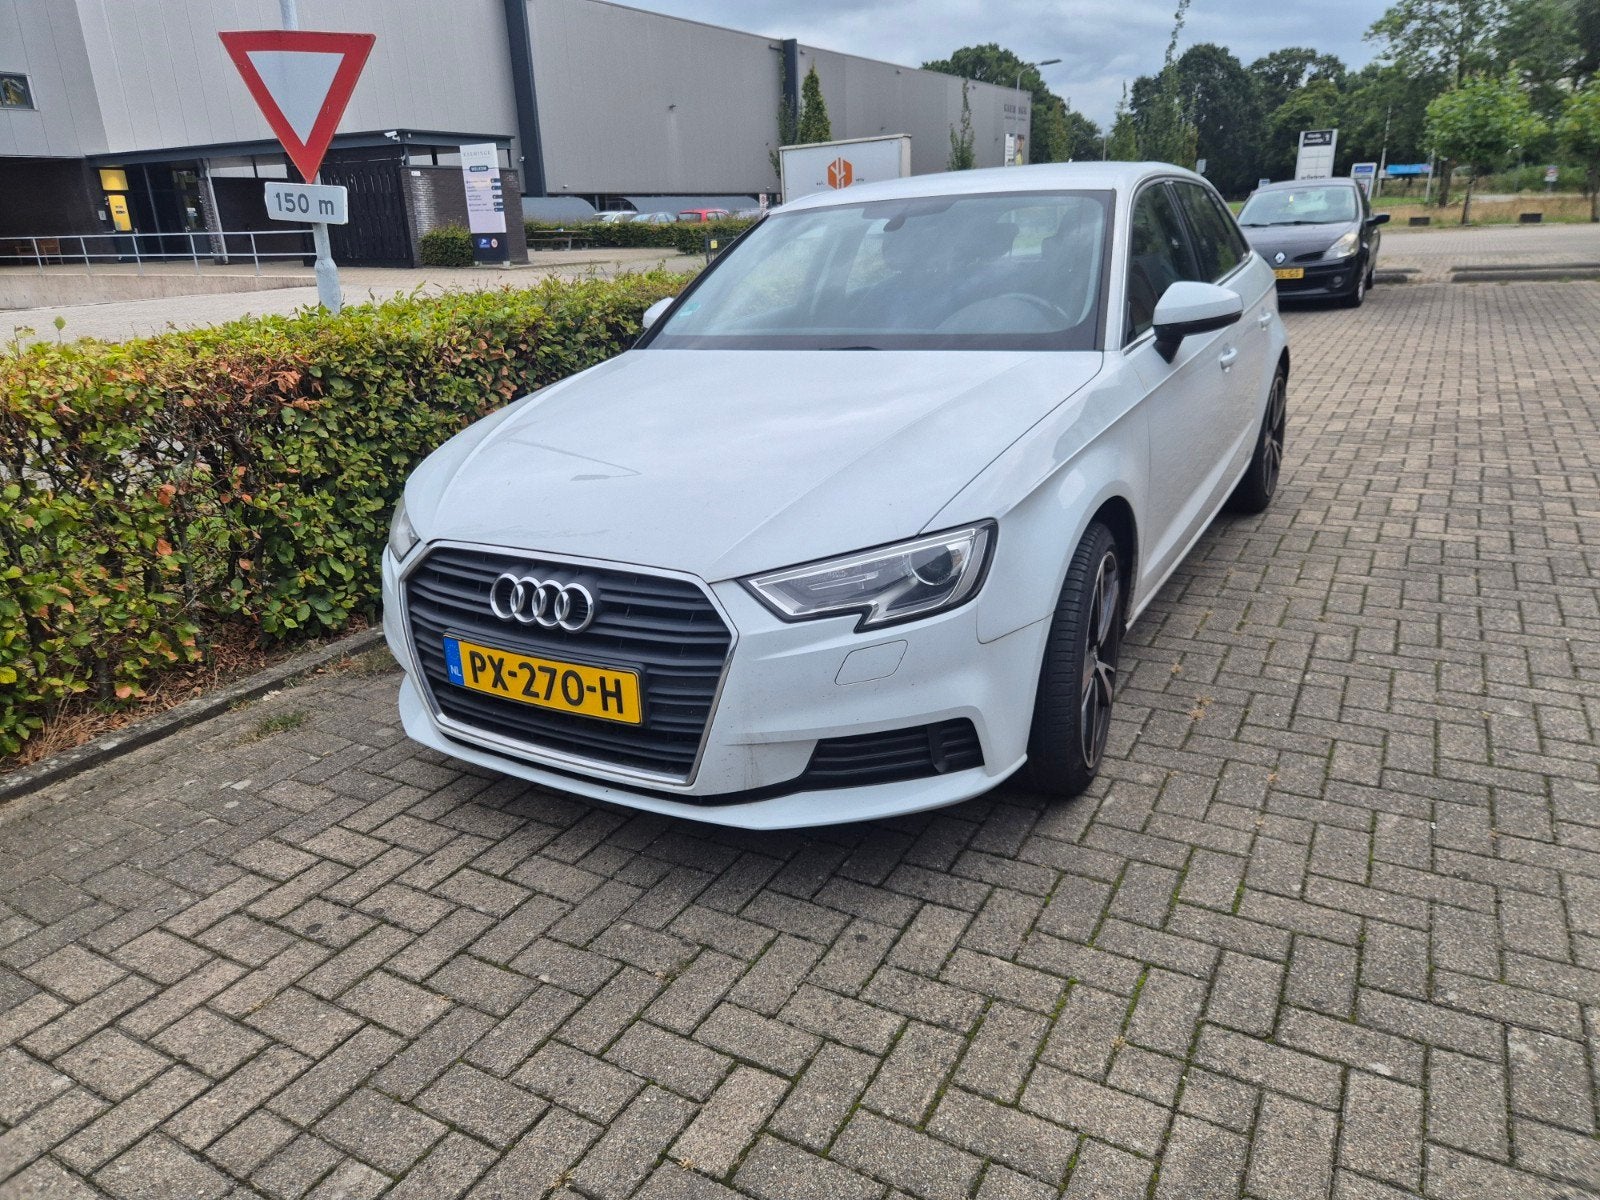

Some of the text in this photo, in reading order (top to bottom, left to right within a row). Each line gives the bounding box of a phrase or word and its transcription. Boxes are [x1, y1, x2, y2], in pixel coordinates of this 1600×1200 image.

[275, 192, 335, 216] 150 m
[450, 664, 463, 677] NL
[469, 650, 624, 714] PX-270-H
